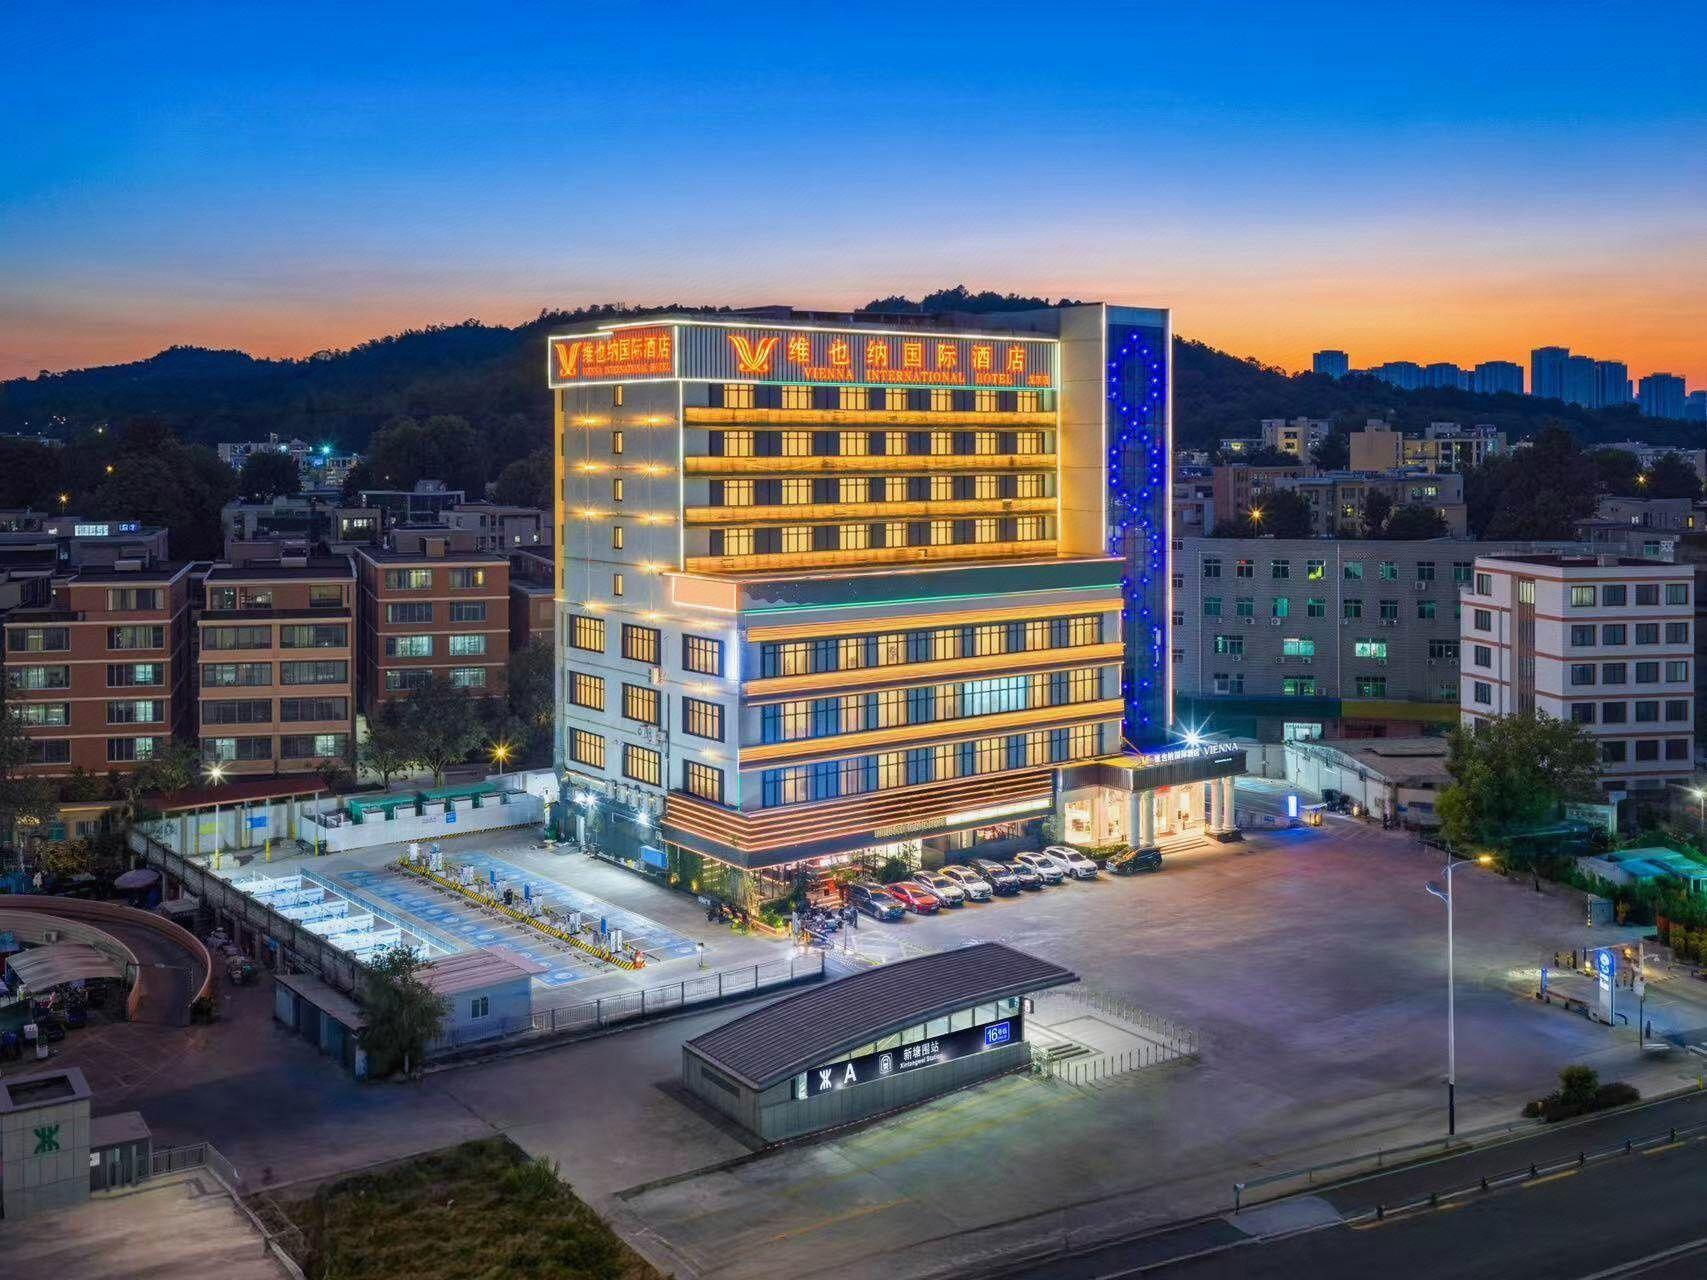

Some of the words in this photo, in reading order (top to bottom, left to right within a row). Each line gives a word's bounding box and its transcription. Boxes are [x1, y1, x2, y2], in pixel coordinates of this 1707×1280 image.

[788, 336, 1024, 371] 维也纳国际酒店
[804, 367, 854, 380] VIENNA
[866, 368, 965, 383] INTERNATIONAL
[976, 373, 1013, 385] HOTEL
[1203, 742, 1239, 755] VIENNA
[843, 1063, 857, 1084] A
